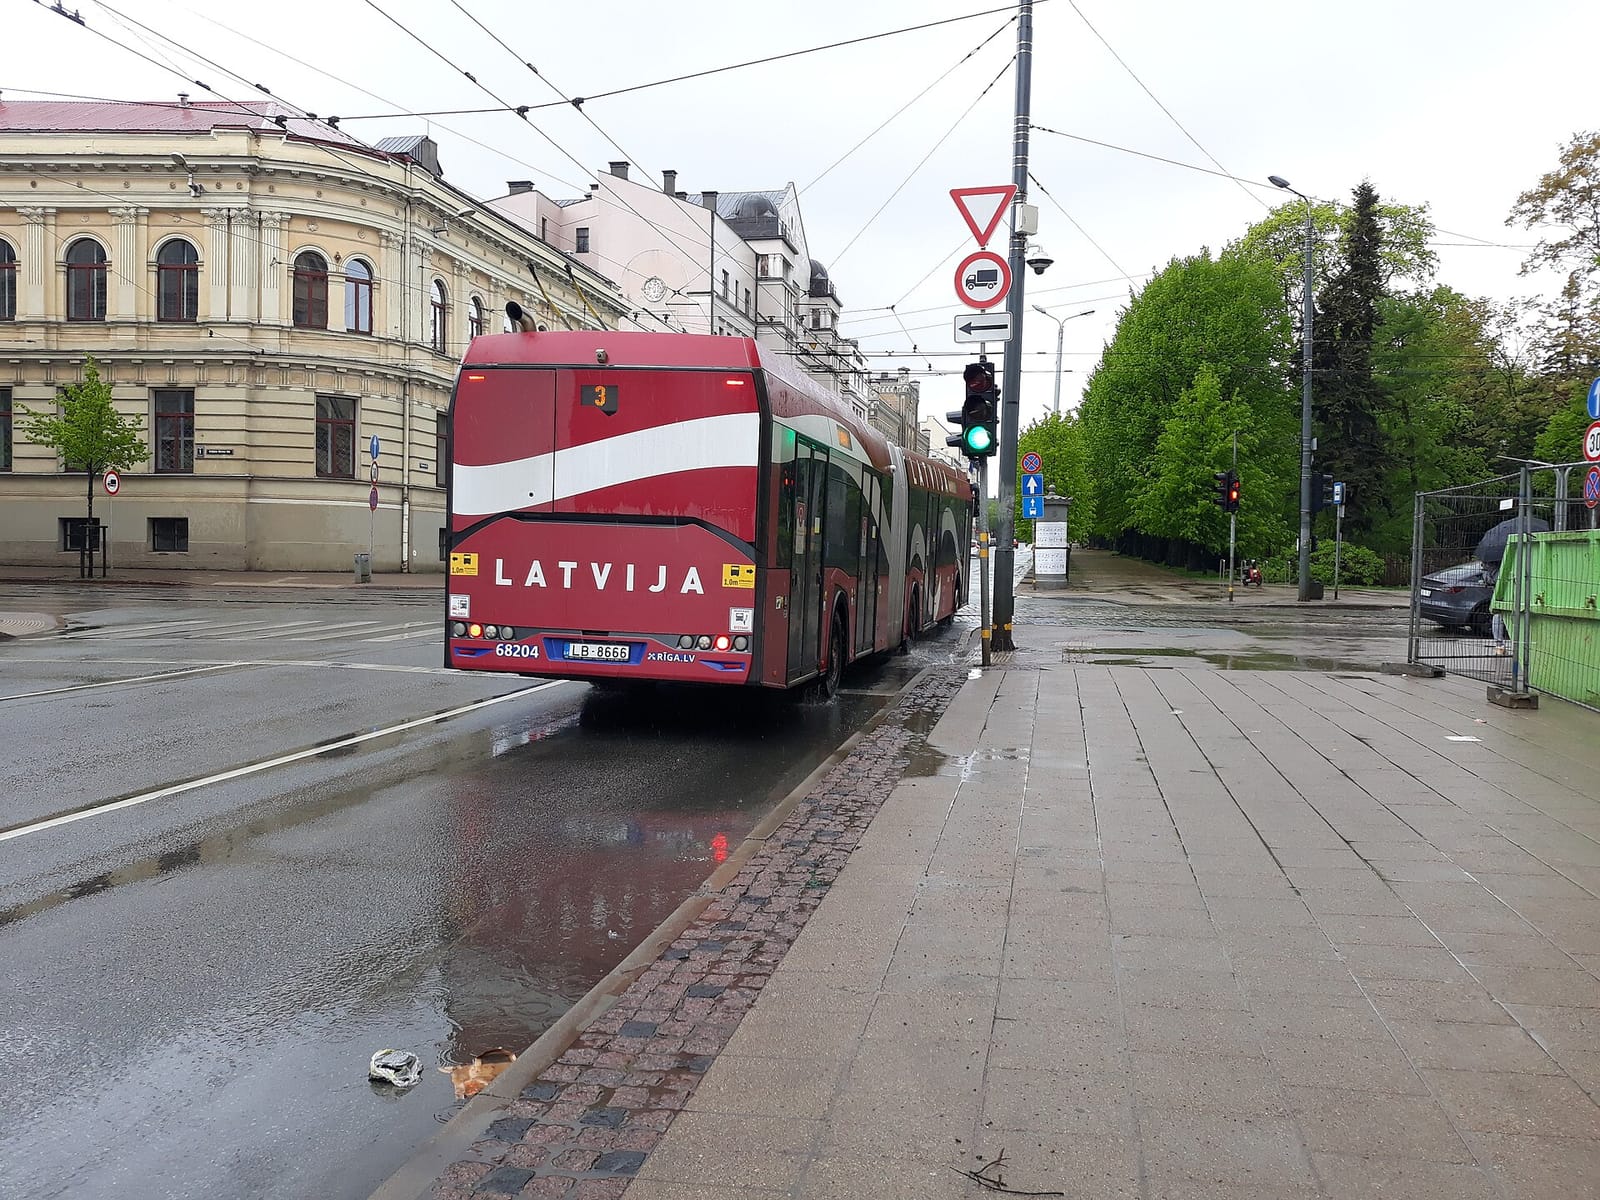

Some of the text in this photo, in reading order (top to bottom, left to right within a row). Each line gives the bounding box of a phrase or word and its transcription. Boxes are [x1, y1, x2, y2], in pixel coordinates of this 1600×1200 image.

[594, 385, 606, 407] 3
[495, 558, 705, 595] LATVIJA
[495, 643, 540, 659] 68204
[572, 644, 627, 659] LB-8666
[656, 651, 696, 663] RĪGA.LV
